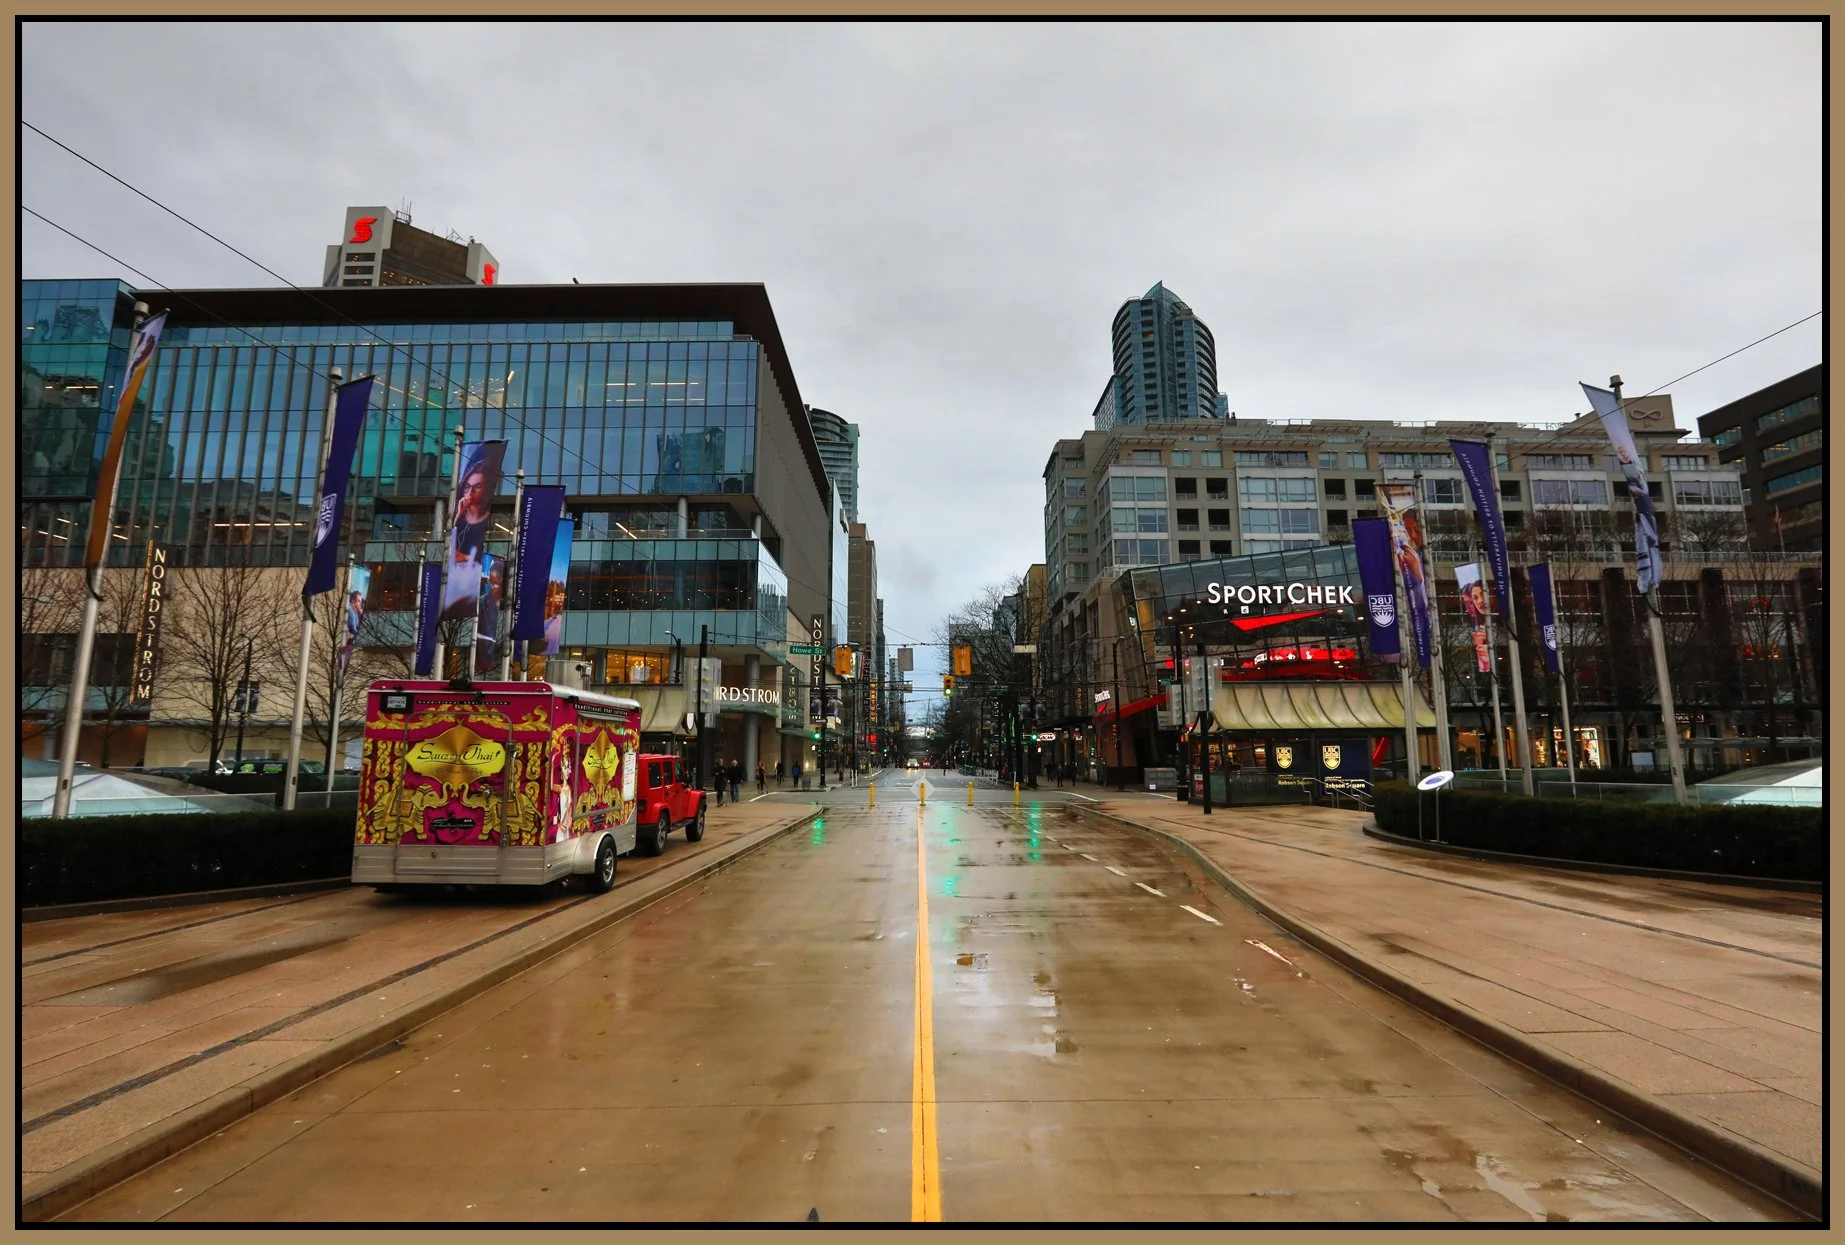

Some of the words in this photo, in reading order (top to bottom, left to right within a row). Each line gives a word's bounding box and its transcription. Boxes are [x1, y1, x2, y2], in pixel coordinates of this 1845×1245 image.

[1207, 582, 1354, 604] SPORTCHEK
[138, 549, 166, 698] NORDSTROM
[716, 686, 780, 704] RDSTROM
[462, 744, 494, 760] Thai
